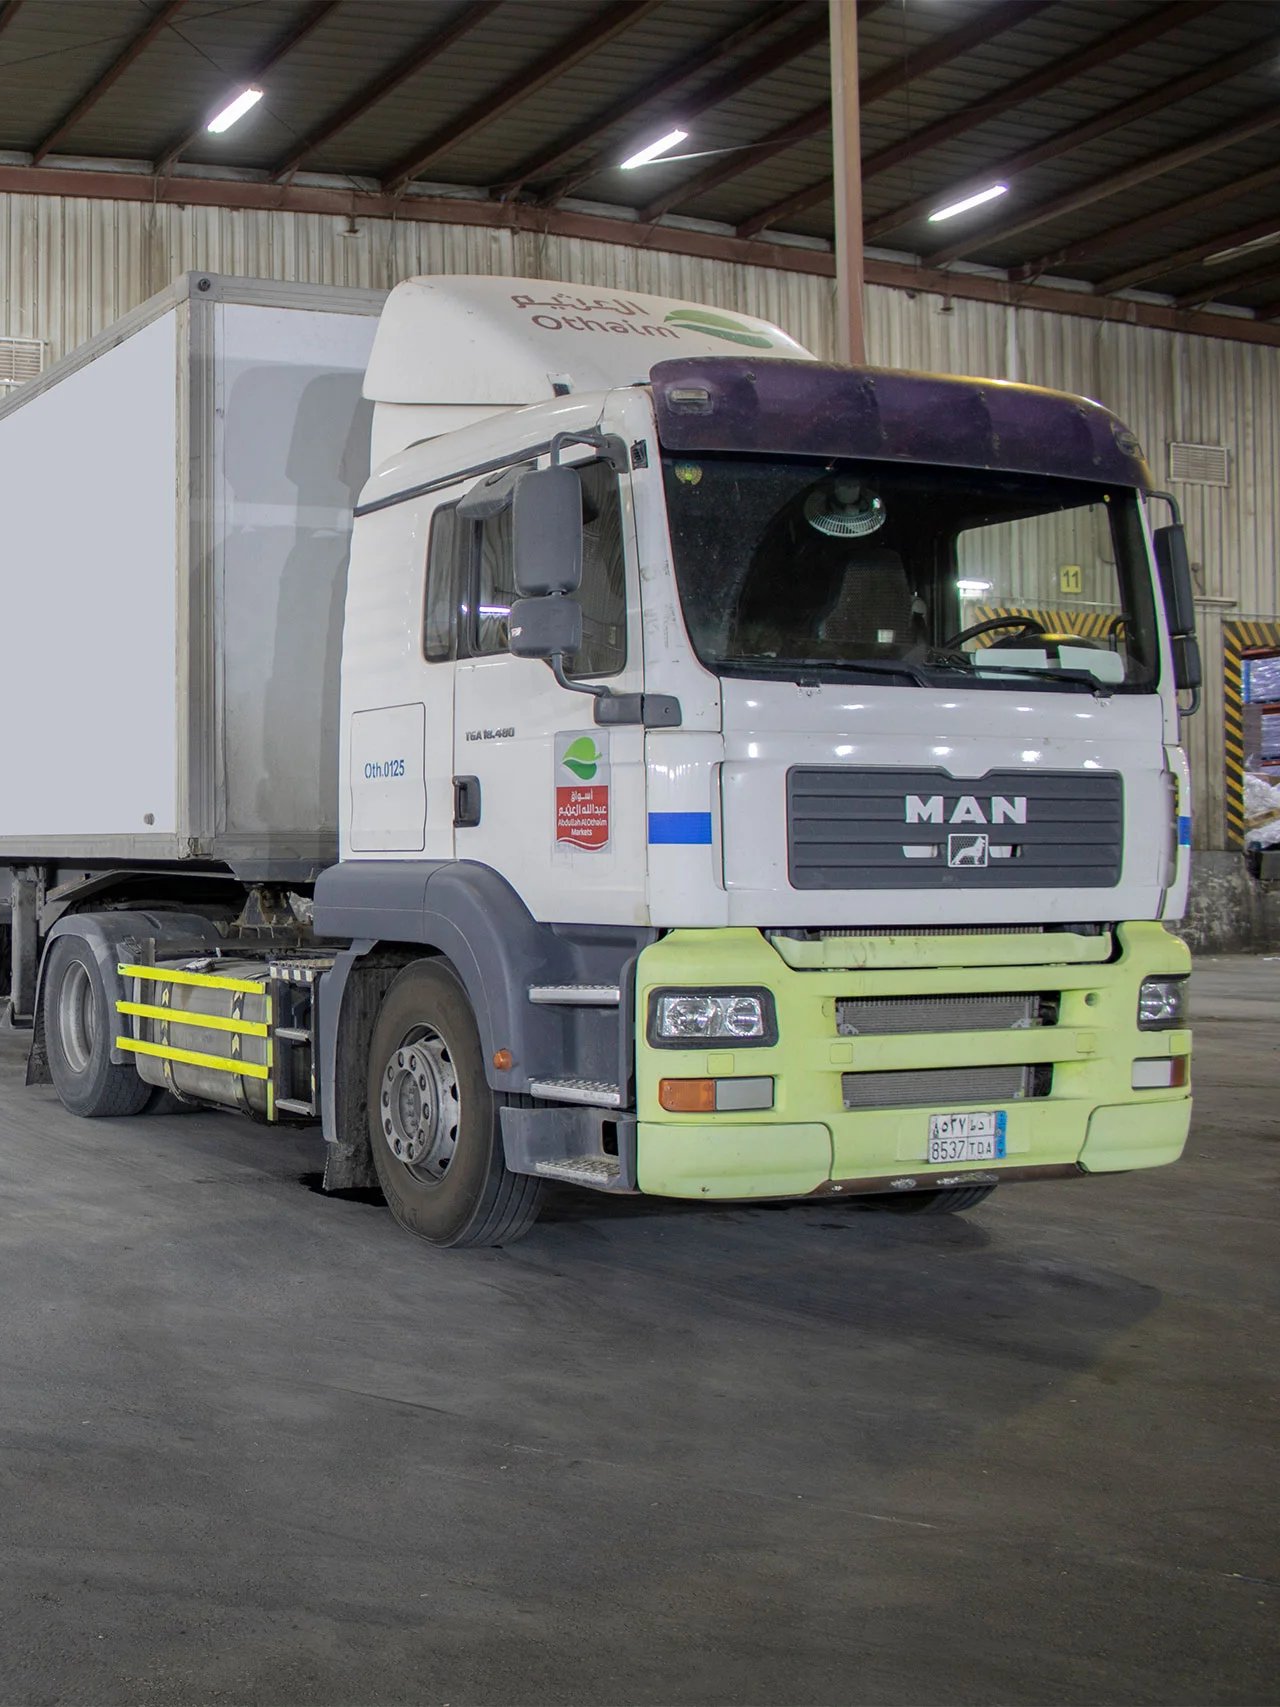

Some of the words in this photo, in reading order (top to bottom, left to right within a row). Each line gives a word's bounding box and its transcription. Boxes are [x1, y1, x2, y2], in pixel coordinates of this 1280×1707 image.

[531, 314, 681, 340] Othaim
[1062, 569, 1080, 589] 11
[364, 759, 405, 779] Oth.0125
[905, 795, 1027, 824] MAN
[931, 1140, 966, 1161] 8537
[969, 1142, 992, 1155] TDA
